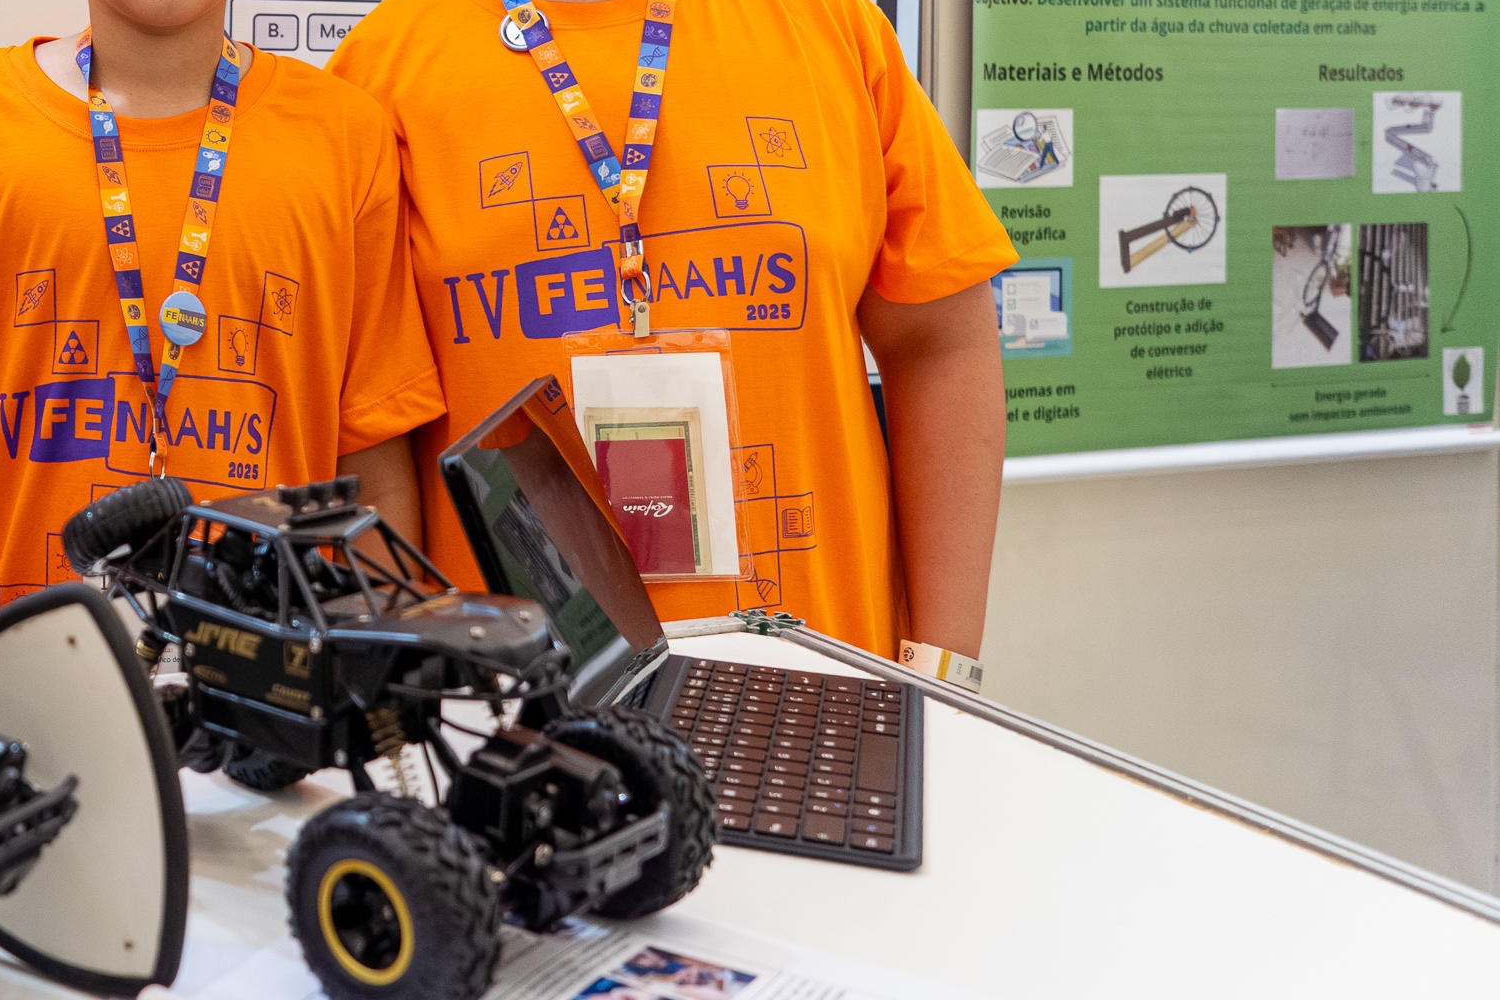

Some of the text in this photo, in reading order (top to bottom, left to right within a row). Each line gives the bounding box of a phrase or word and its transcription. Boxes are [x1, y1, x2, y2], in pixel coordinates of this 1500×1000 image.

[1371, 0, 1418, 15] energia
[1421, 0, 1470, 12] elétrica
[1474, 1, 1485, 12] a
[268, 22, 284, 38] B.
[1085, 17, 1376, 37] partir da água da chuva coletada em calhas
[984, 63, 1163, 81] Materiais e Métodos
[1318, 64, 1404, 81] Resultados
[1001, 205, 1051, 218] Revisão
[443, 269, 510, 344] IV
[746, 303, 791, 321] 2025
[1125, 297, 1212, 314] Construção de
[1114, 319, 1224, 340] protótipo e adição
[1130, 344, 1208, 358] de conversor
[1146, 366, 1192, 379] elétrico
[228, 461, 259, 480] 2025
